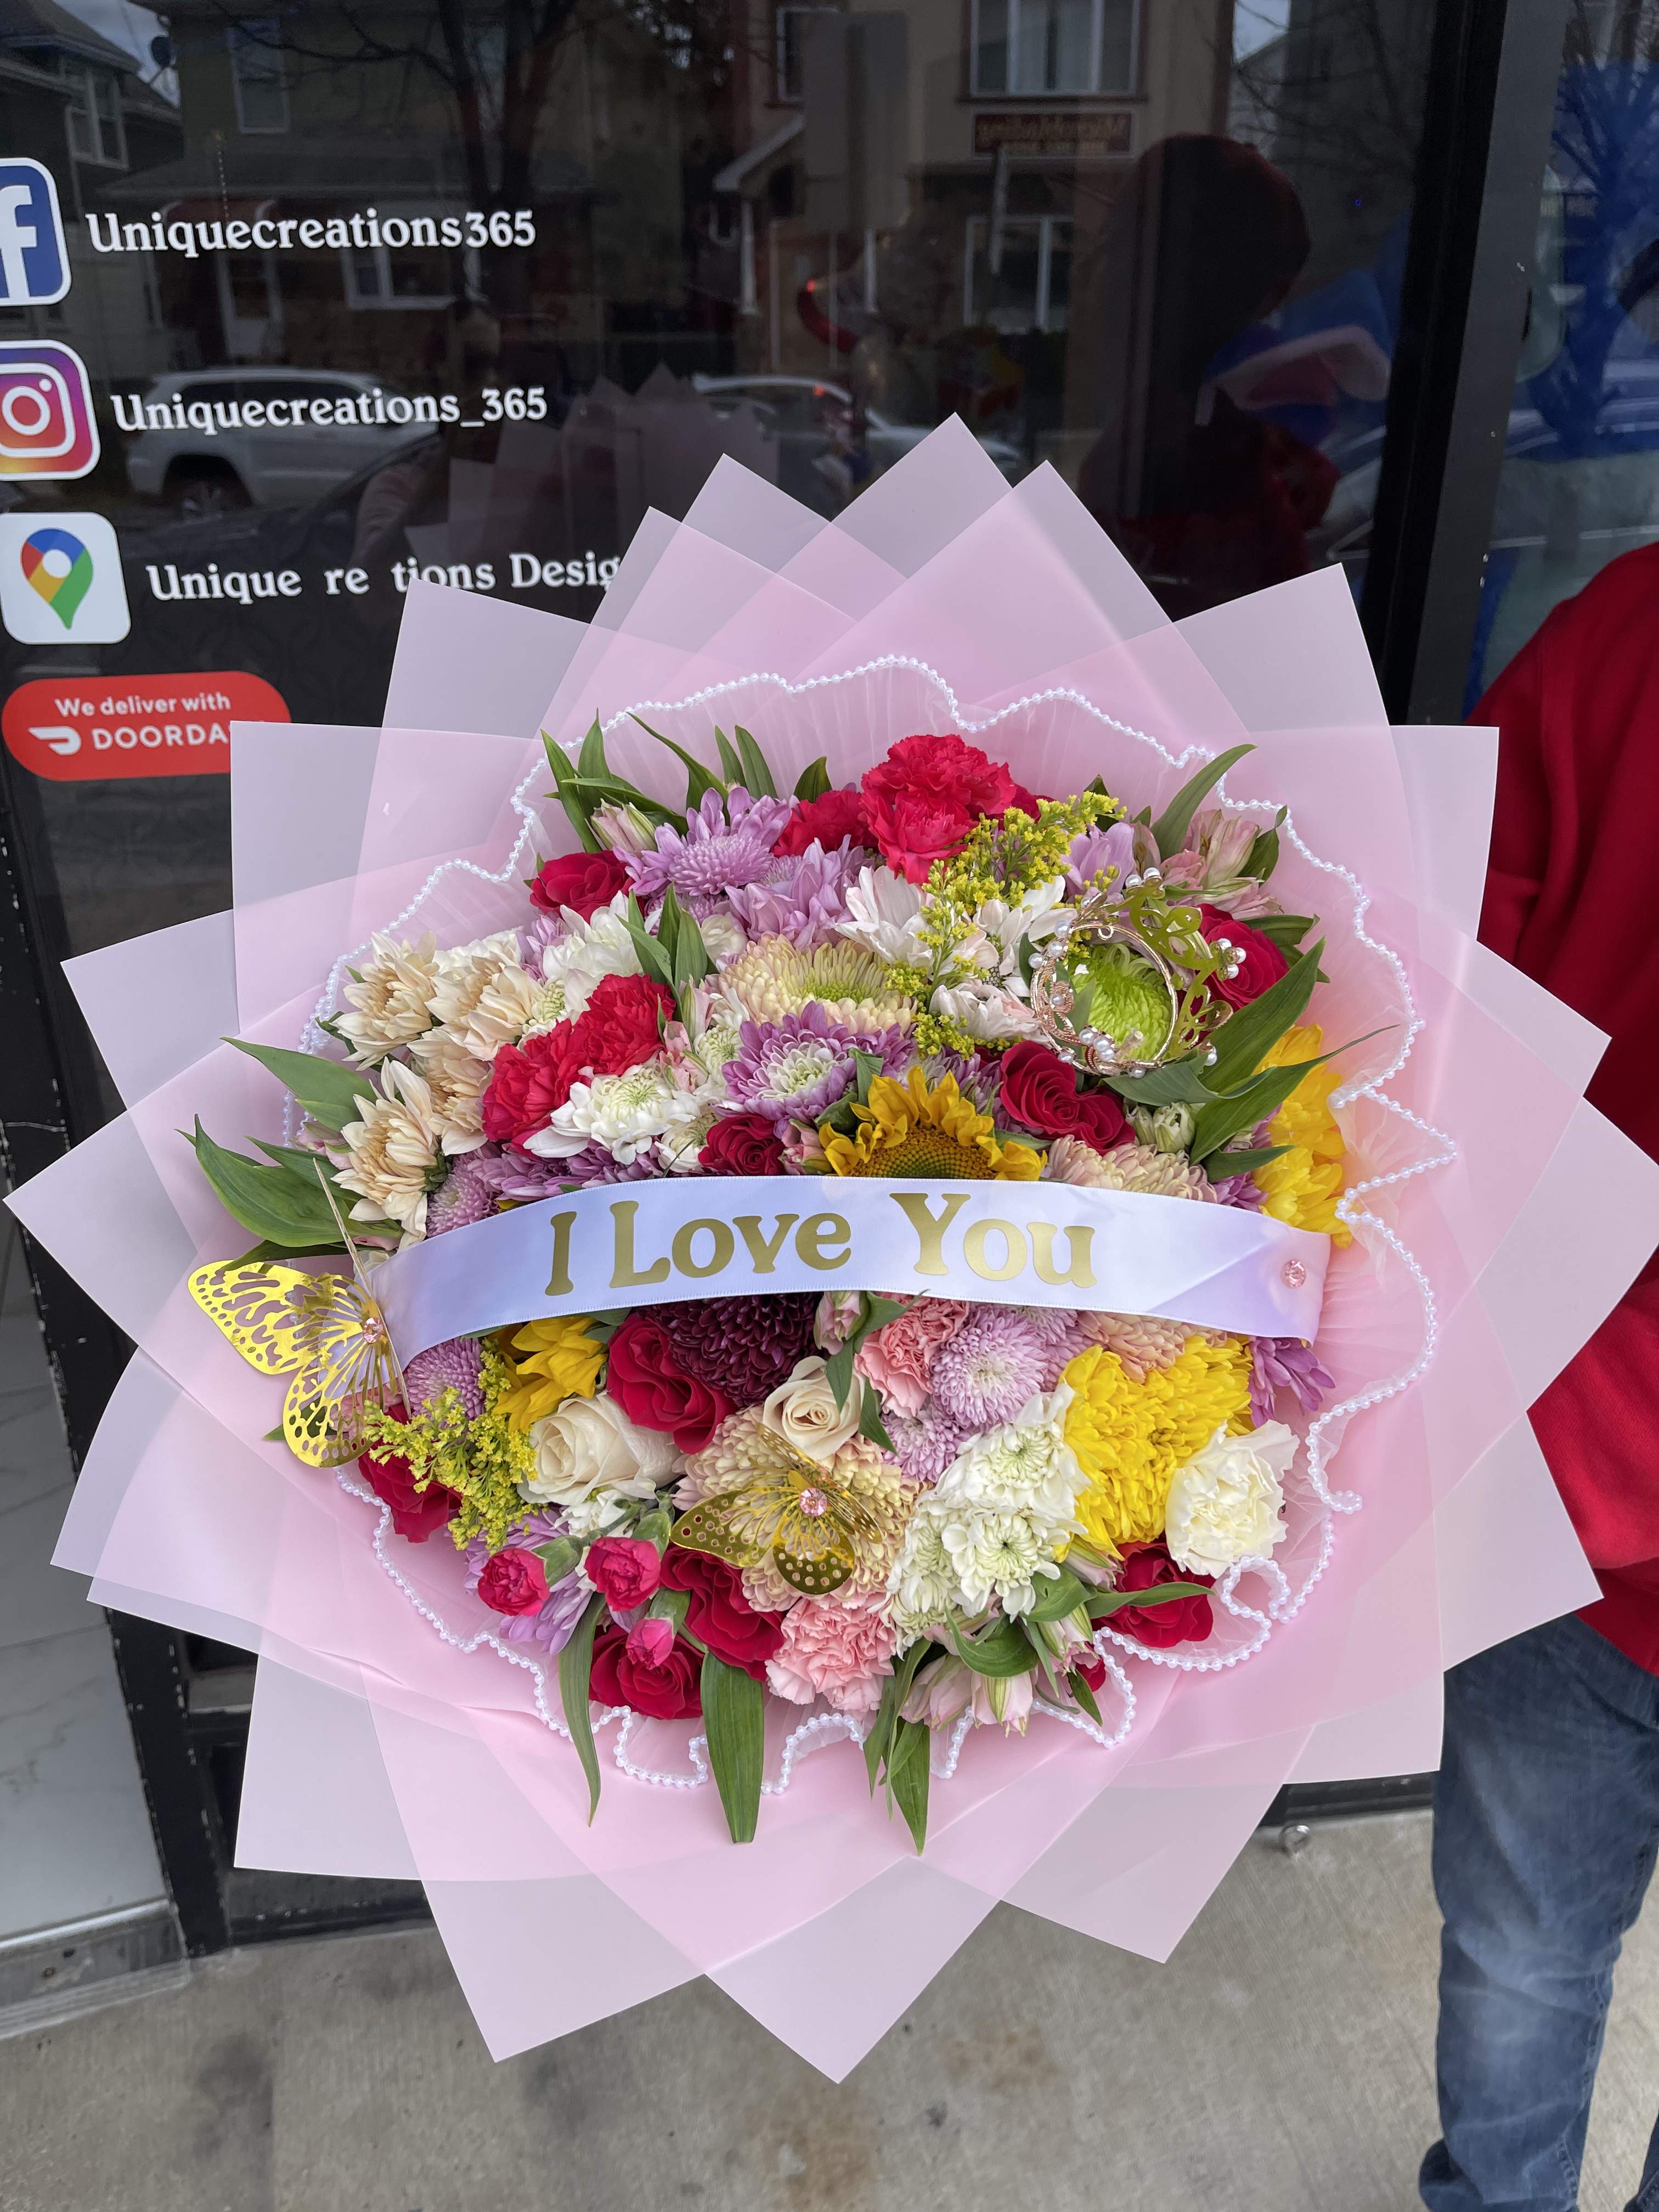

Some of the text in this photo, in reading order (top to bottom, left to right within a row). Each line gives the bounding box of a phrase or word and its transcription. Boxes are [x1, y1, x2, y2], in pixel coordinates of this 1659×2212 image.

[85, 207, 537, 258] Uniquecreations365
[109, 387, 548, 436] Uniquecreations_365
[145, 563, 302, 605] Unique
[54, 691, 232, 717] We deliver with
[91, 721, 231, 751] DOORDA
[545, 1192, 1097, 1296] I Love You
